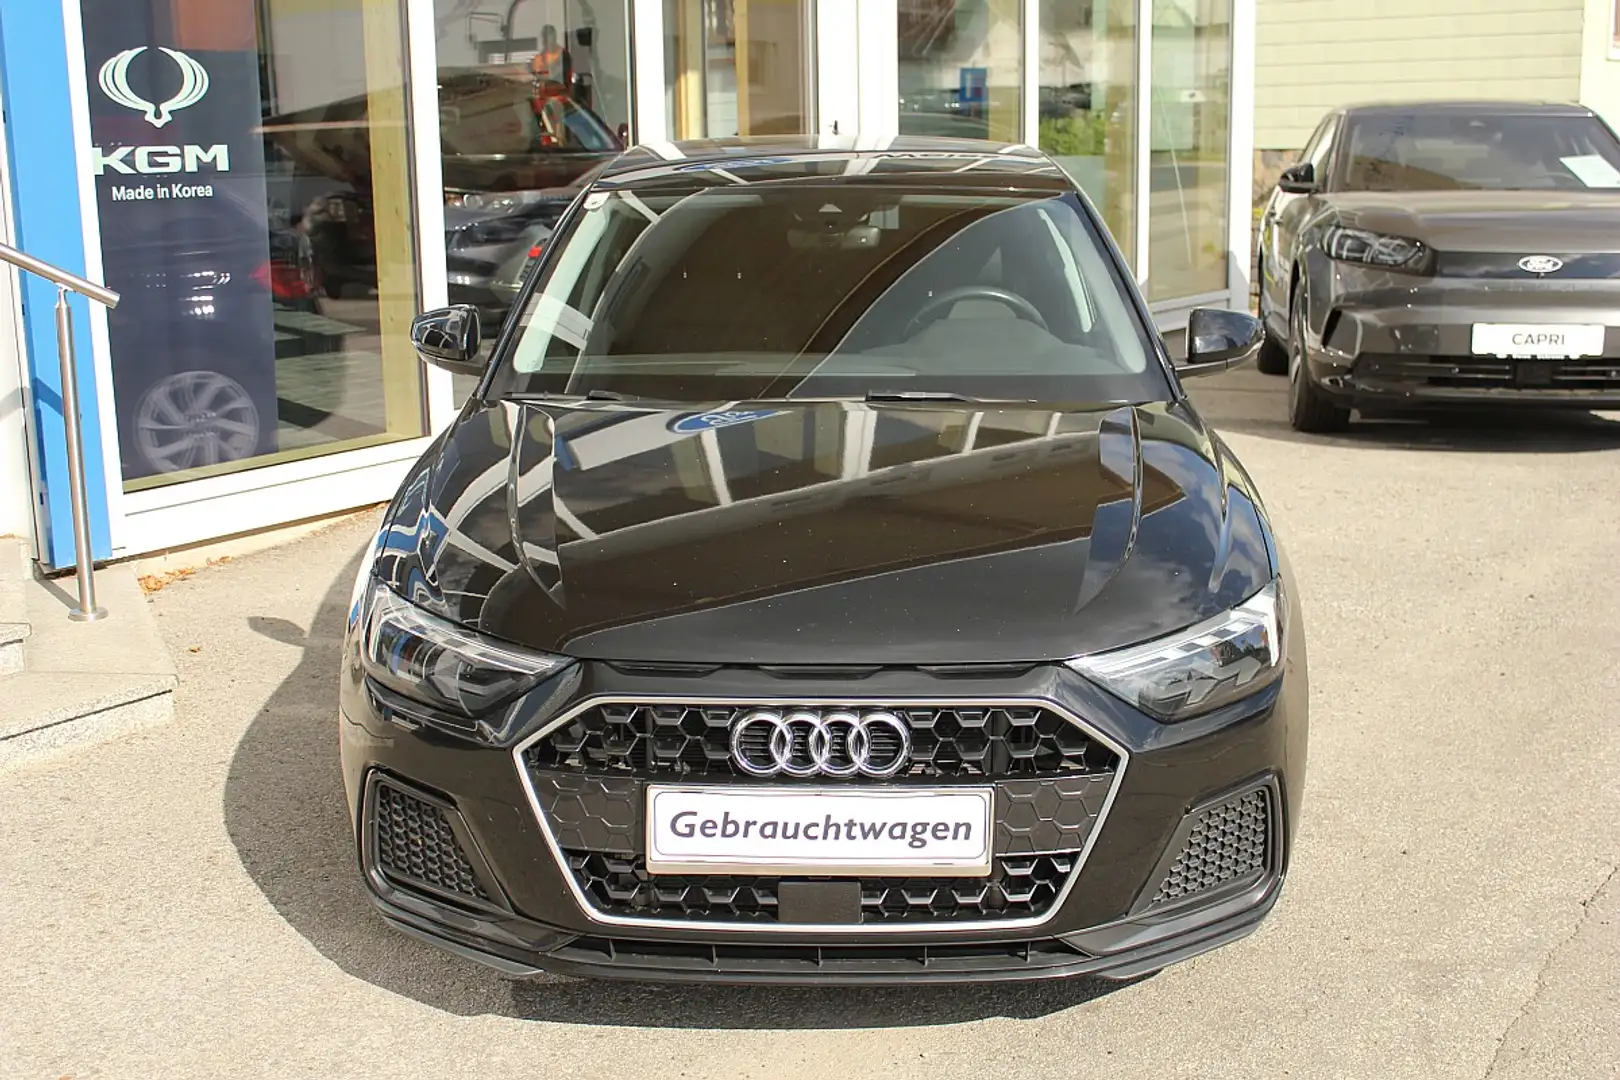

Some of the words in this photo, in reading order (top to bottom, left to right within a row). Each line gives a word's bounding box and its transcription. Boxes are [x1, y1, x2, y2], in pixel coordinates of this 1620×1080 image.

[92, 144, 230, 175] KGM
[111, 185, 154, 201] Made
[156, 184, 169, 198] in
[171, 183, 213, 198] Korea
[1512, 333, 1565, 346] CAPRI
[669, 811, 972, 849] Gebrauchtwagen
